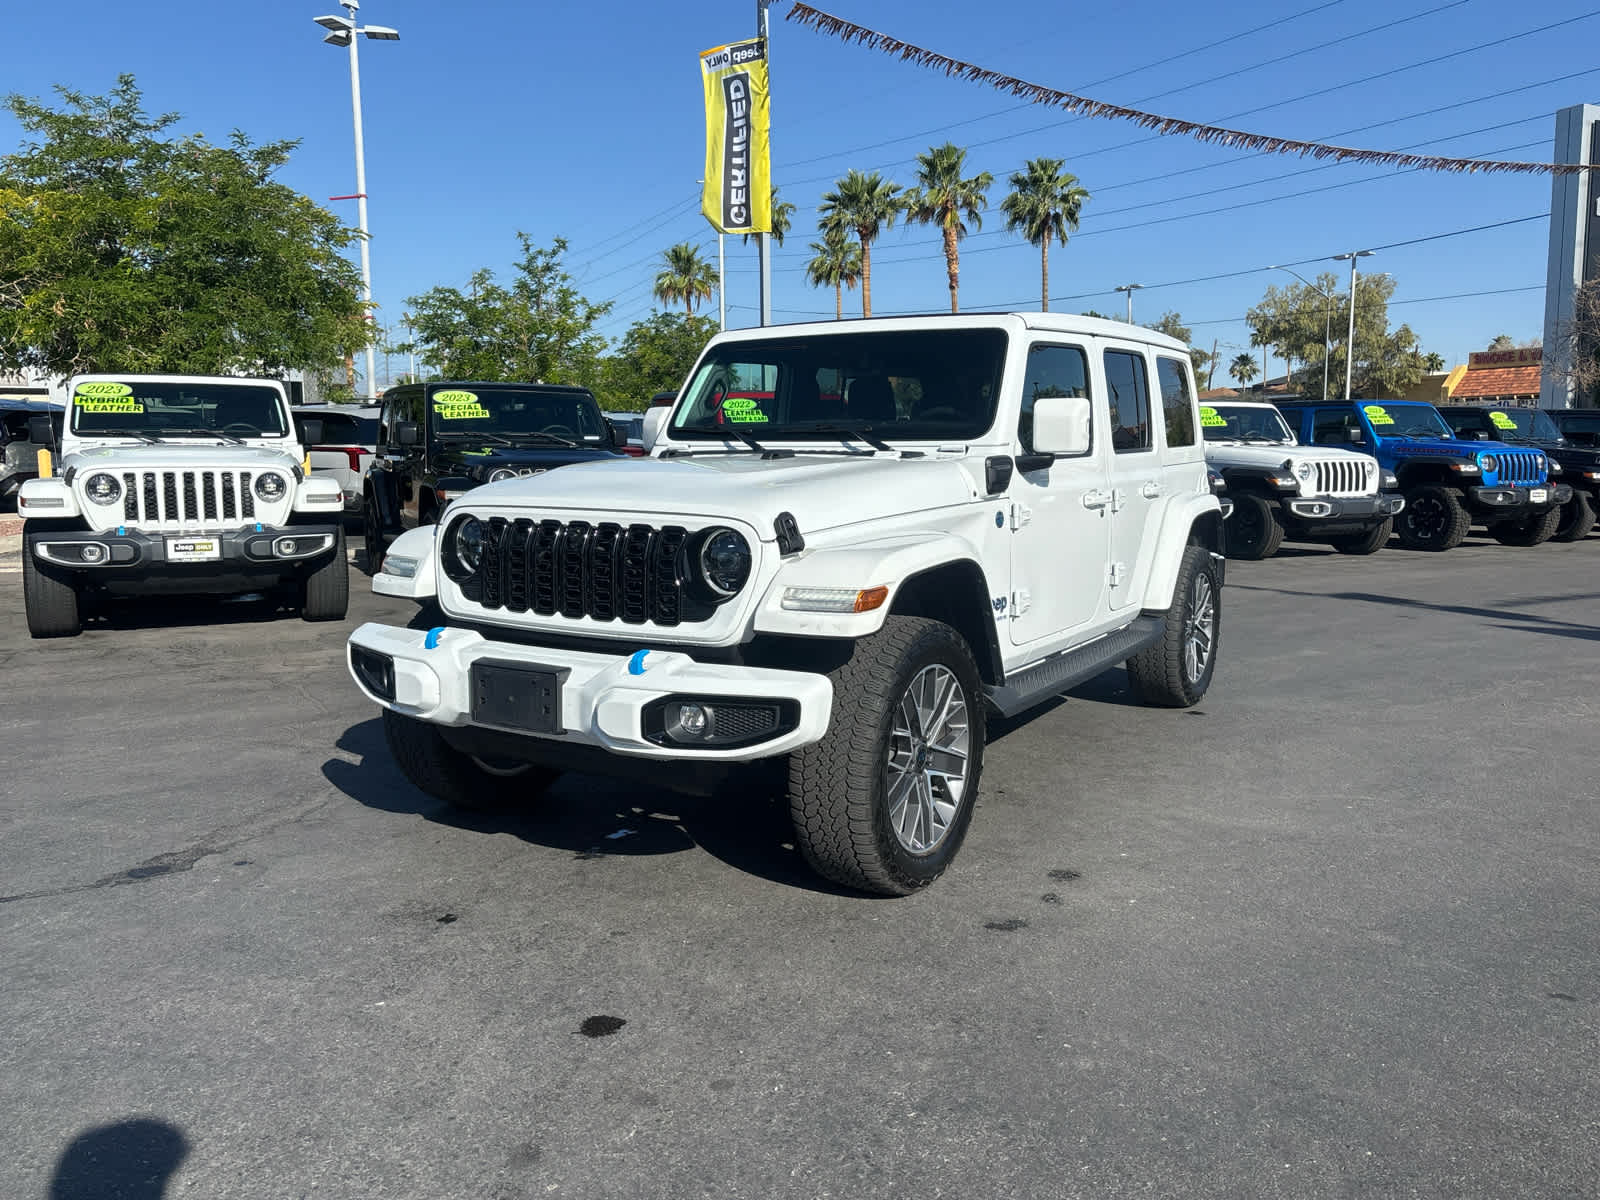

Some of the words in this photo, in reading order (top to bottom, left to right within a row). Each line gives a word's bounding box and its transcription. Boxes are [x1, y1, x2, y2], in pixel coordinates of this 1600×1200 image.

[86, 384, 123, 394] 2023
[79, 396, 129, 404] HYBRID
[441, 393, 471, 402] 2023
[85, 404, 141, 412] LEATHER
